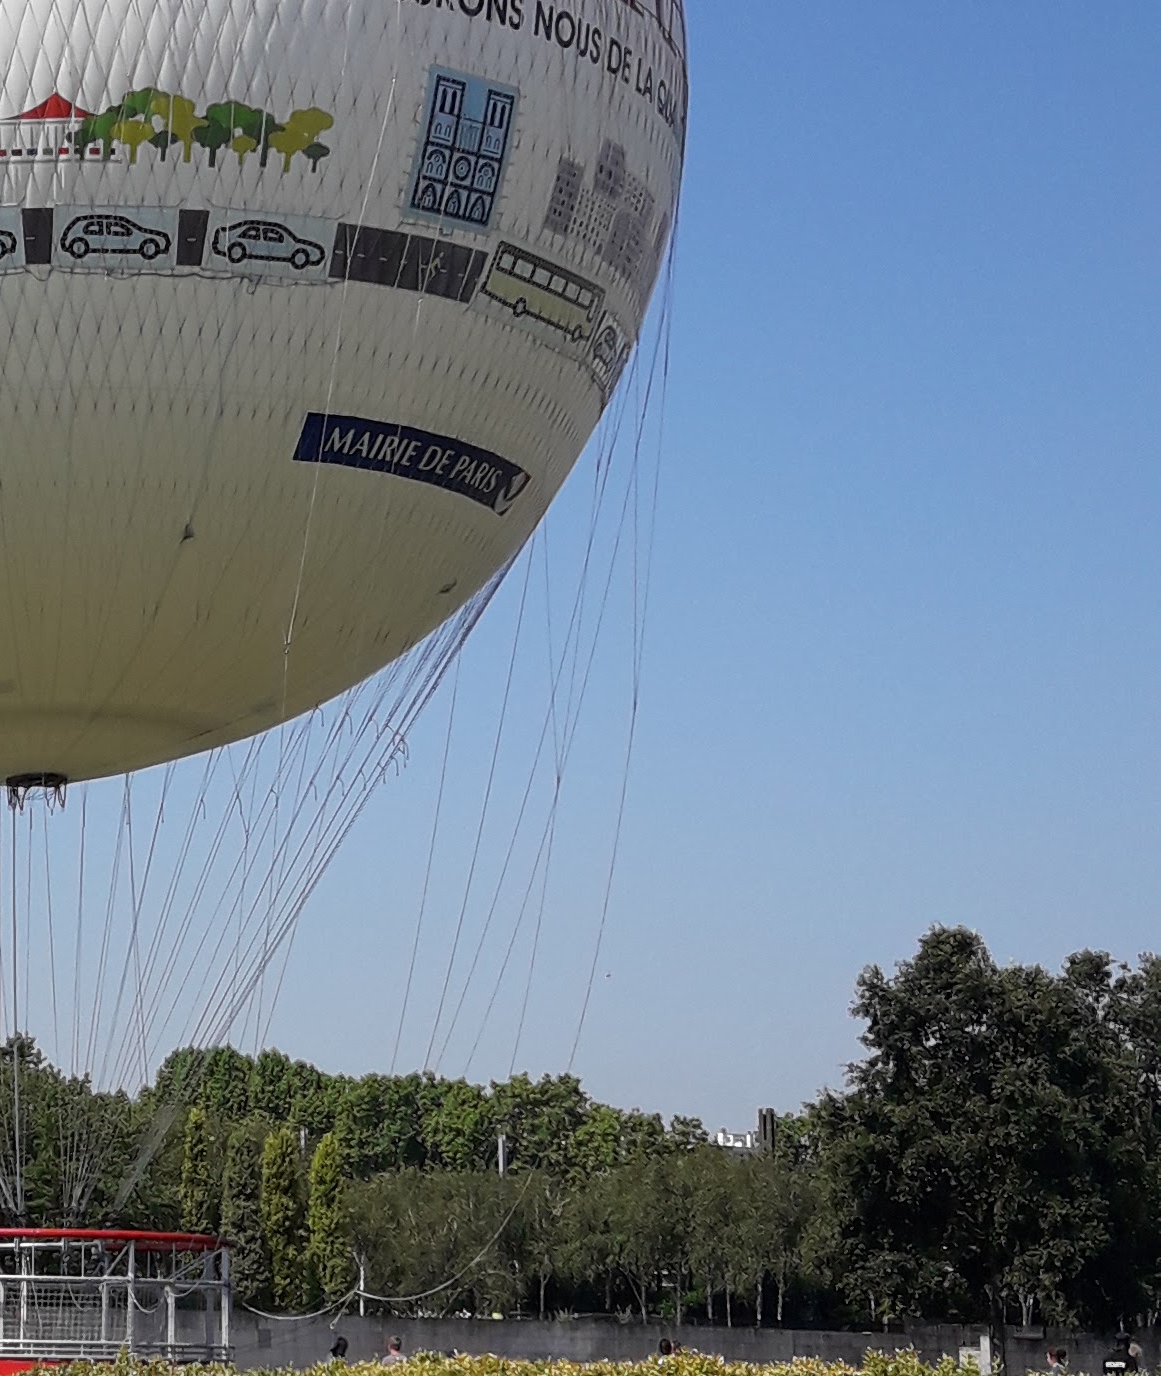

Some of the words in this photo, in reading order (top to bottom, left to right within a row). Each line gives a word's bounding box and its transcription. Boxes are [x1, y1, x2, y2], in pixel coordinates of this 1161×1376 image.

[534, 0, 602, 65] NOUS
[606, 37, 632, 84] DE
[635, 57, 653, 104] LA
[324, 427, 422, 466] MAIRIE
[419, 445, 455, 475] DE
[450, 455, 503, 492] PARIS
